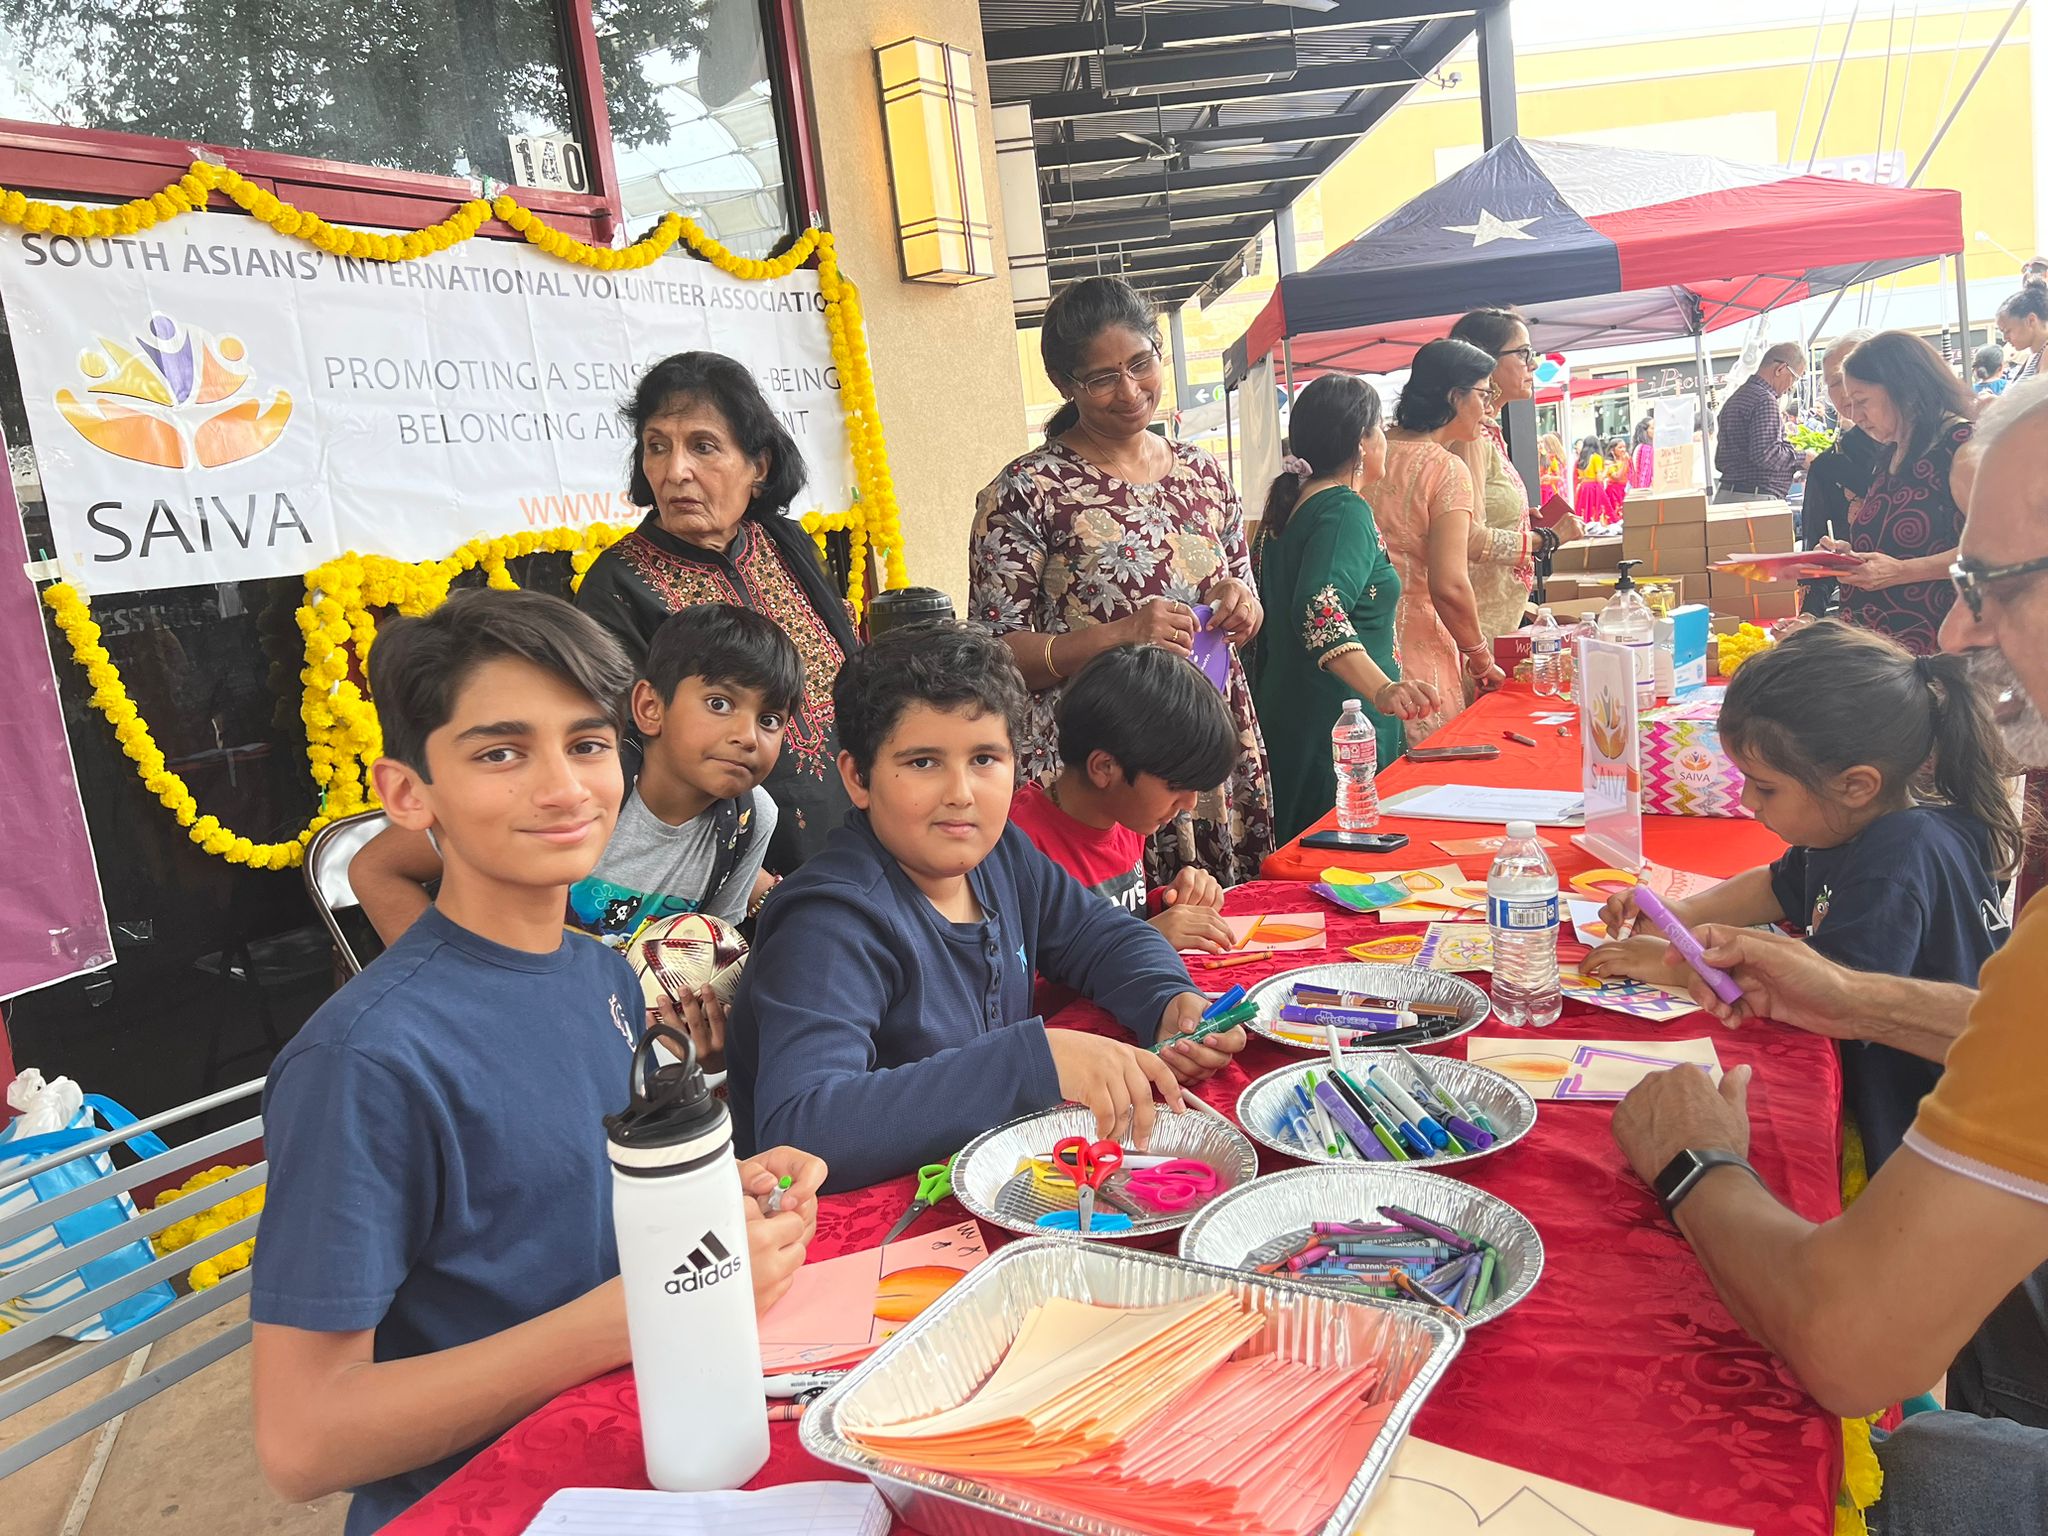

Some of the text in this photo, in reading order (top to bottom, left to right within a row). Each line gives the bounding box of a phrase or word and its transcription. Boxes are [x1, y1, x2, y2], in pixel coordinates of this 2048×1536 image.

[21, 233, 829, 313] SOUTH ASIANS' INTERNATIONAL VOLUNTEER ASSOCIATIO
[324, 356, 538, 390] PROMOTING
[547, 362, 568, 390] A
[574, 362, 641, 391] SENS
[397, 411, 636, 445] BELONGING AN
[86, 492, 313, 562] SAIVA
[1679, 771, 1711, 783] SAIVA
[664, 1255, 742, 1295] adidas
